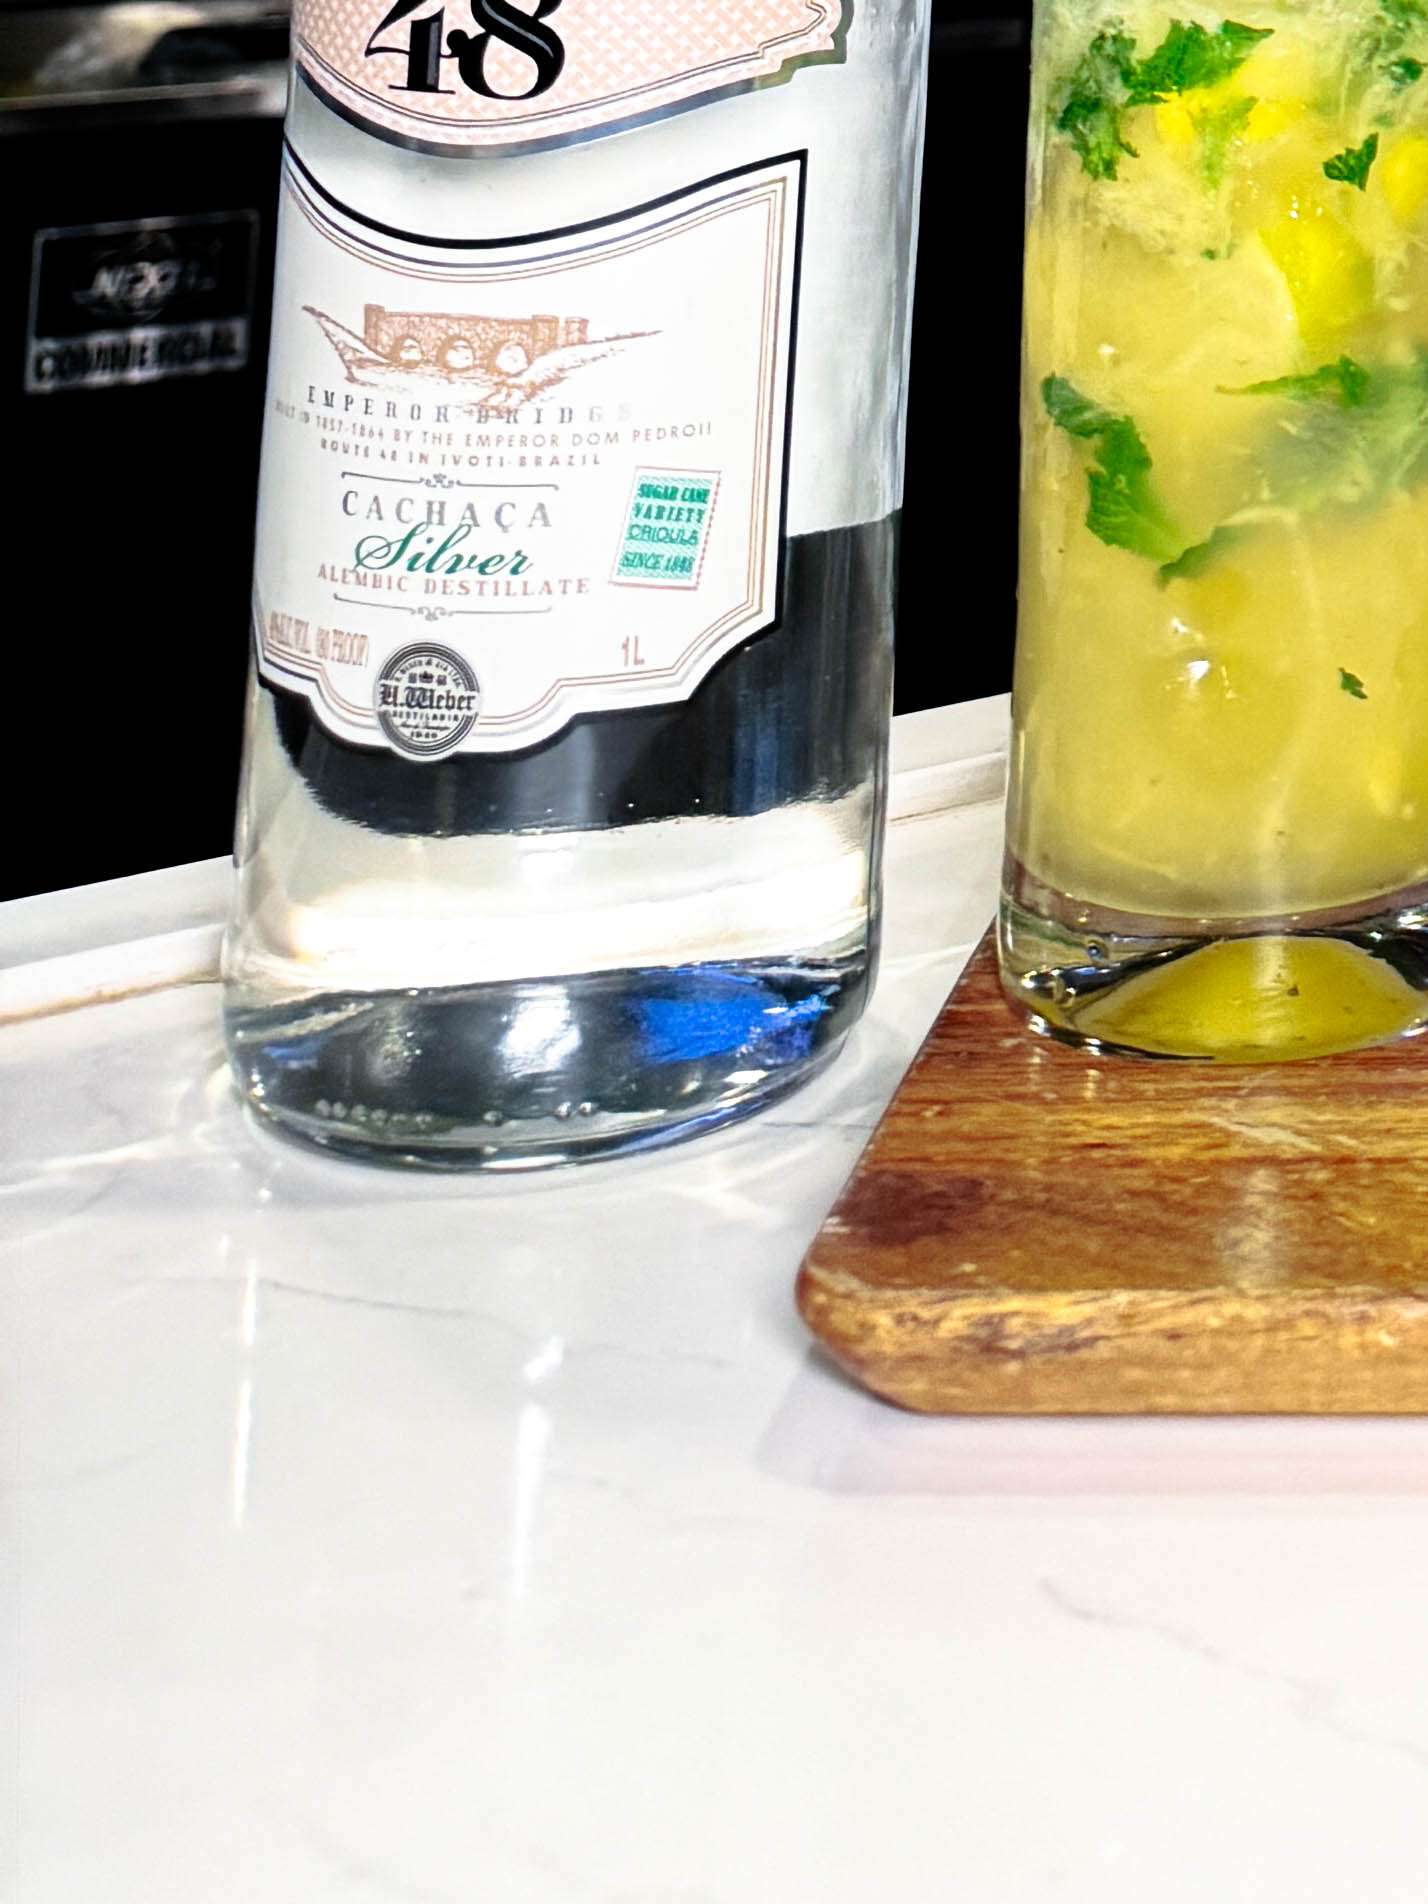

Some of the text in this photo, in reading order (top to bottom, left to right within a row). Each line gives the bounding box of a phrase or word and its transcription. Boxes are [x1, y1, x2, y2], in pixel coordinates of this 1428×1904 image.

[306, 384, 450, 424] EMPEROR
[422, 430, 454, 447] THE
[464, 433, 560, 448] EMPEROR
[571, 432, 620, 448] DOM
[408, 451, 429, 465] IN
[341, 490, 553, 534] CACHAÇA
[353, 521, 535, 576] Silver
[316, 562, 593, 597] ALEMBIC DESTILLATE
